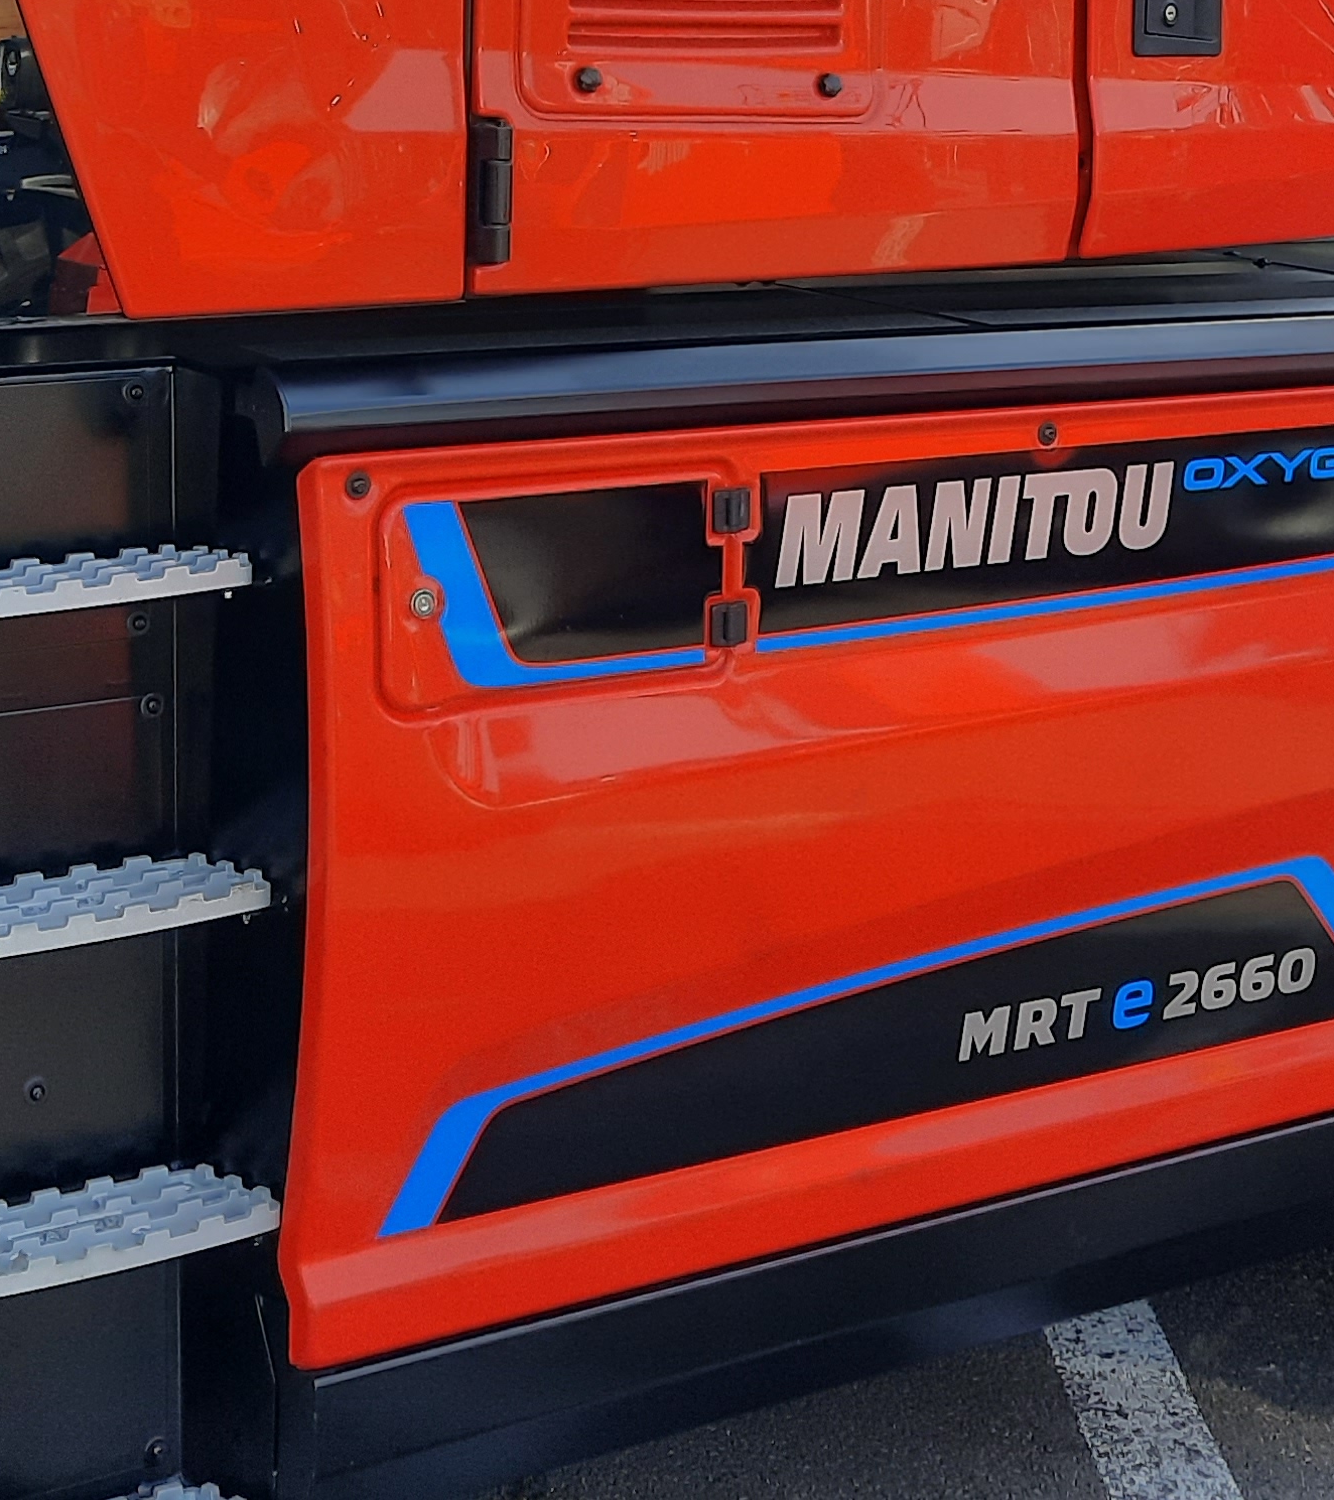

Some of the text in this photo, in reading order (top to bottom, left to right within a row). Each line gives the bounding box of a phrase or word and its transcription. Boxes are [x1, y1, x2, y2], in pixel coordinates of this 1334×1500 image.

[774, 460, 1174, 589] MANITOU
[957, 946, 1317, 1063] MRT e 2660
